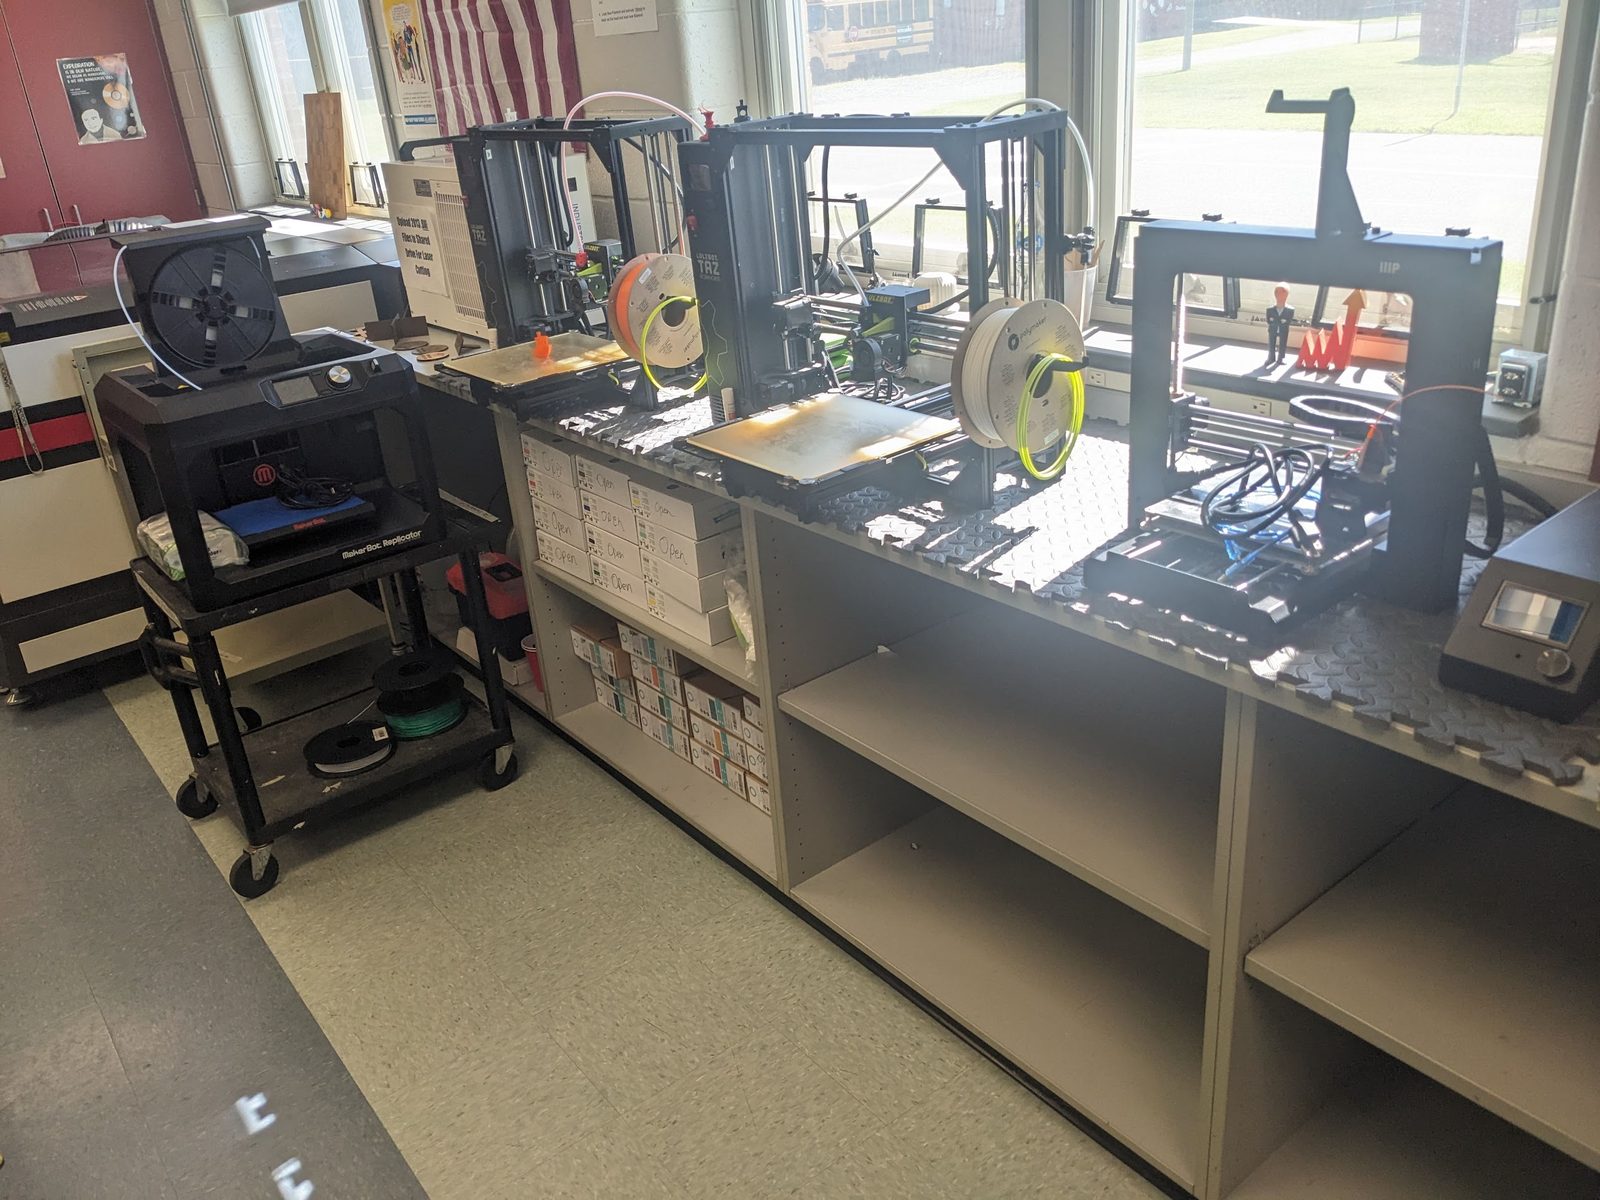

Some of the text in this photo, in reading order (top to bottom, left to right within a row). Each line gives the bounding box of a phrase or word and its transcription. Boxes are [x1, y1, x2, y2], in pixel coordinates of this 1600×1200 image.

[697, 260, 721, 276] TAZ
[1020, 316, 1047, 342] polymaker
[551, 511, 573, 538] Open
[382, 530, 422, 547] Replicator
[554, 546, 578, 567] Open
[658, 536, 688, 565] Open
[611, 573, 633, 593] Open
